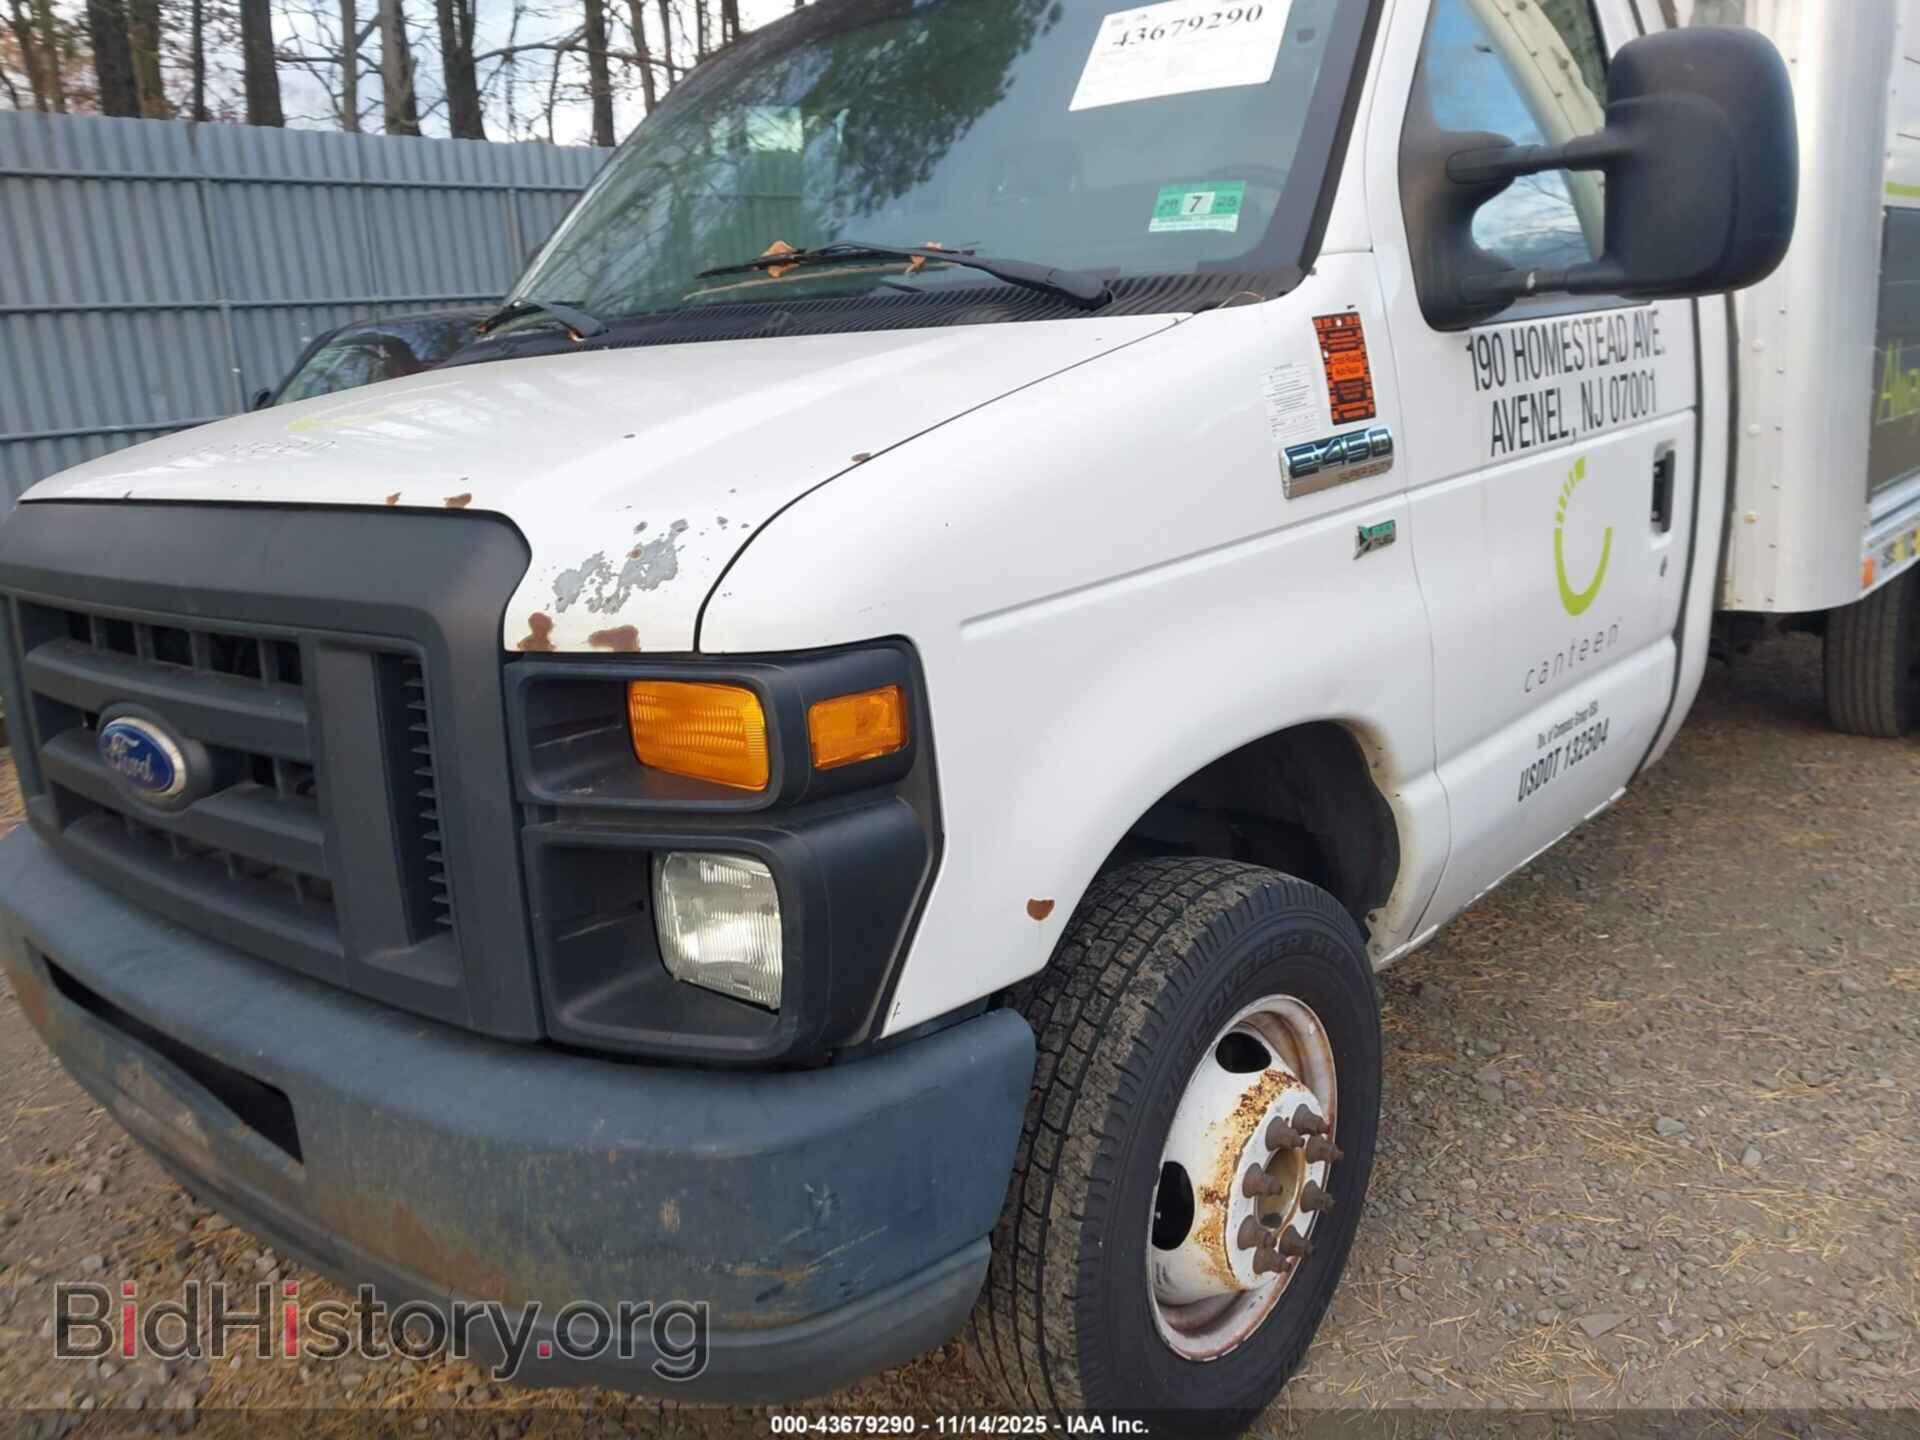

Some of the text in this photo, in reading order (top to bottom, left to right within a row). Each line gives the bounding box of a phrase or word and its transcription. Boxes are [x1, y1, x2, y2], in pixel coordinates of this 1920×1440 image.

[1113, 4, 1263, 47] 43679290
[1190, 195, 1203, 213] 7
[1466, 308, 1666, 392] 190 HOMESTEAD AVE.
[1490, 368, 1657, 457] AVENEL, NJ 07001
[1283, 427, 1393, 479] E-450
[1524, 623, 1618, 693] canteen
[102, 732, 154, 783] Ford
[1518, 747, 1562, 802] USDOT
[1563, 717, 1610, 770] 132504
